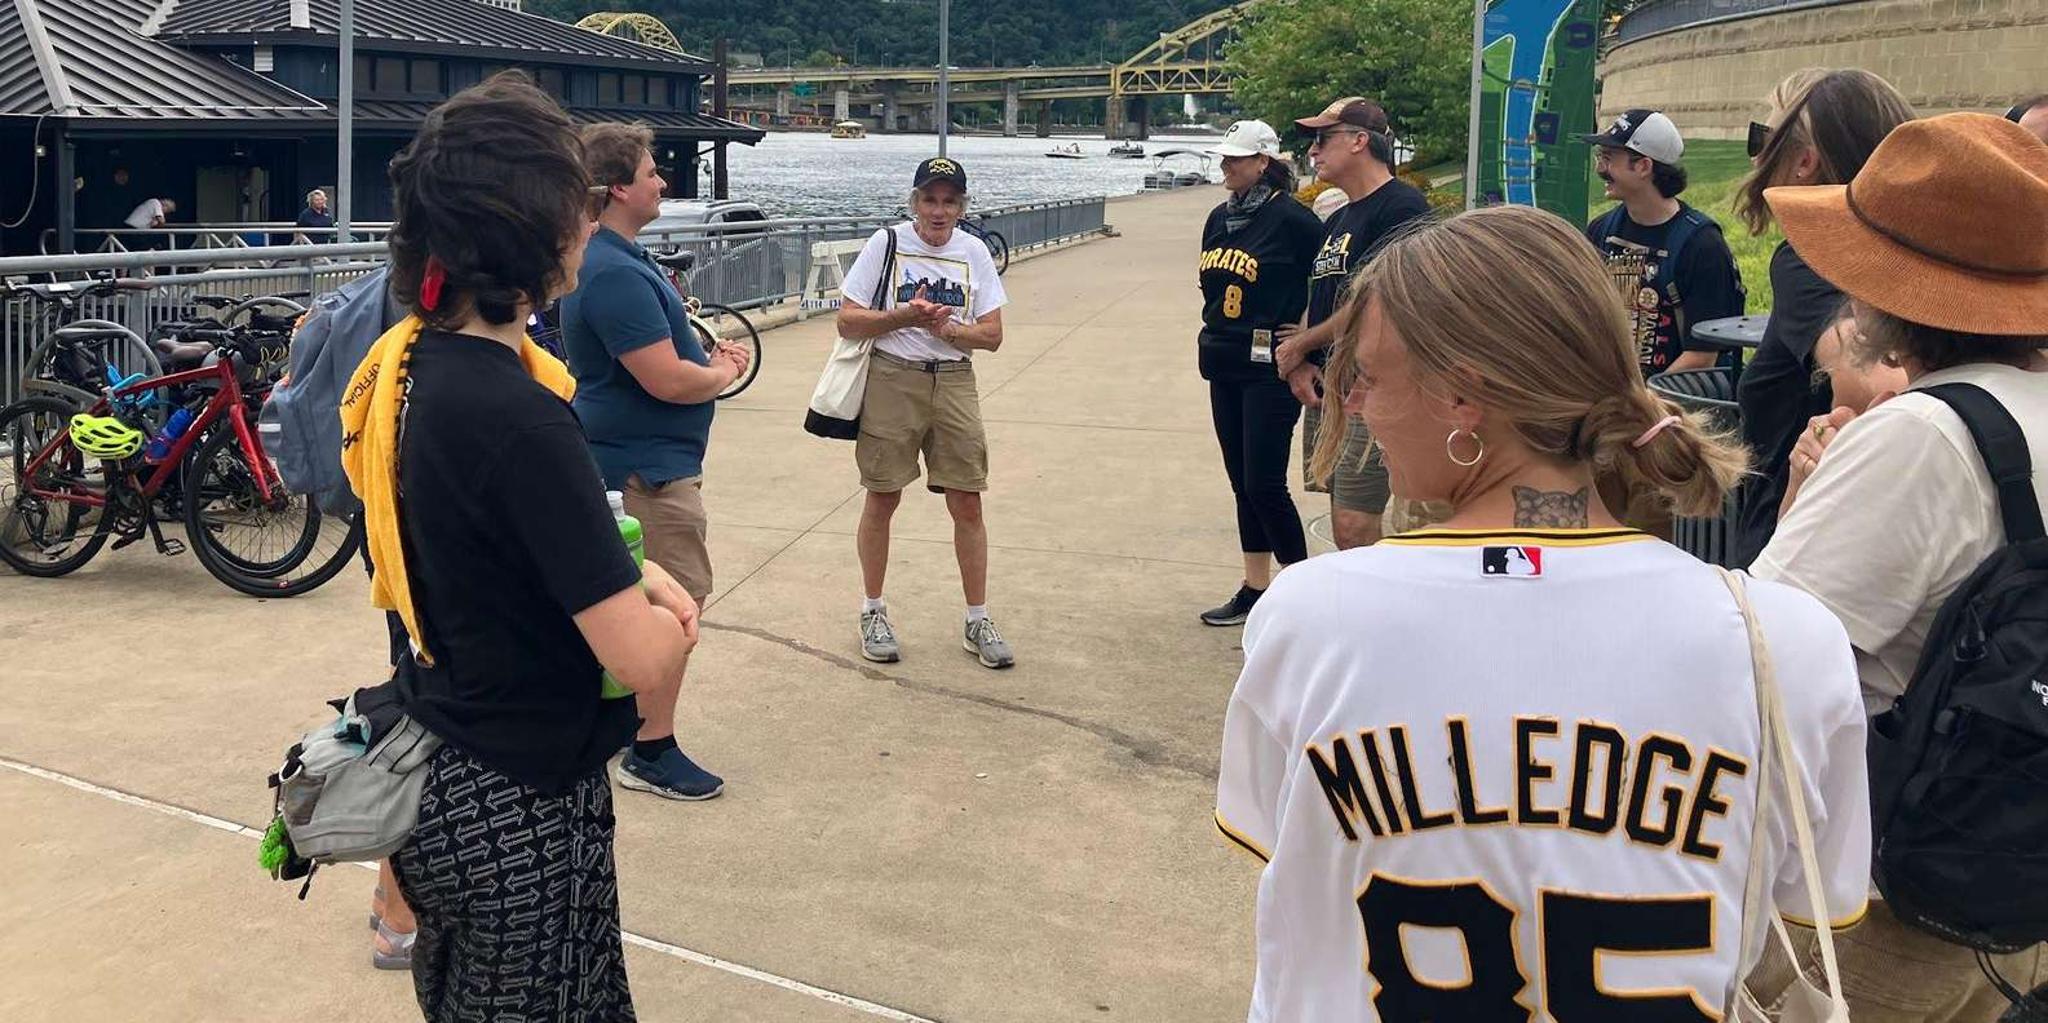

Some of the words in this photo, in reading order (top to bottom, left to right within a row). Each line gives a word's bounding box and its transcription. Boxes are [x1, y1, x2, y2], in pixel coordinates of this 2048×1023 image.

[1226, 125, 1239, 137] P
[1223, 284, 1243, 319] 8
[343, 362, 381, 409] OFFICIAL
[1305, 713, 1748, 863] MILLEDGE
[1356, 871, 1727, 1023] 85
